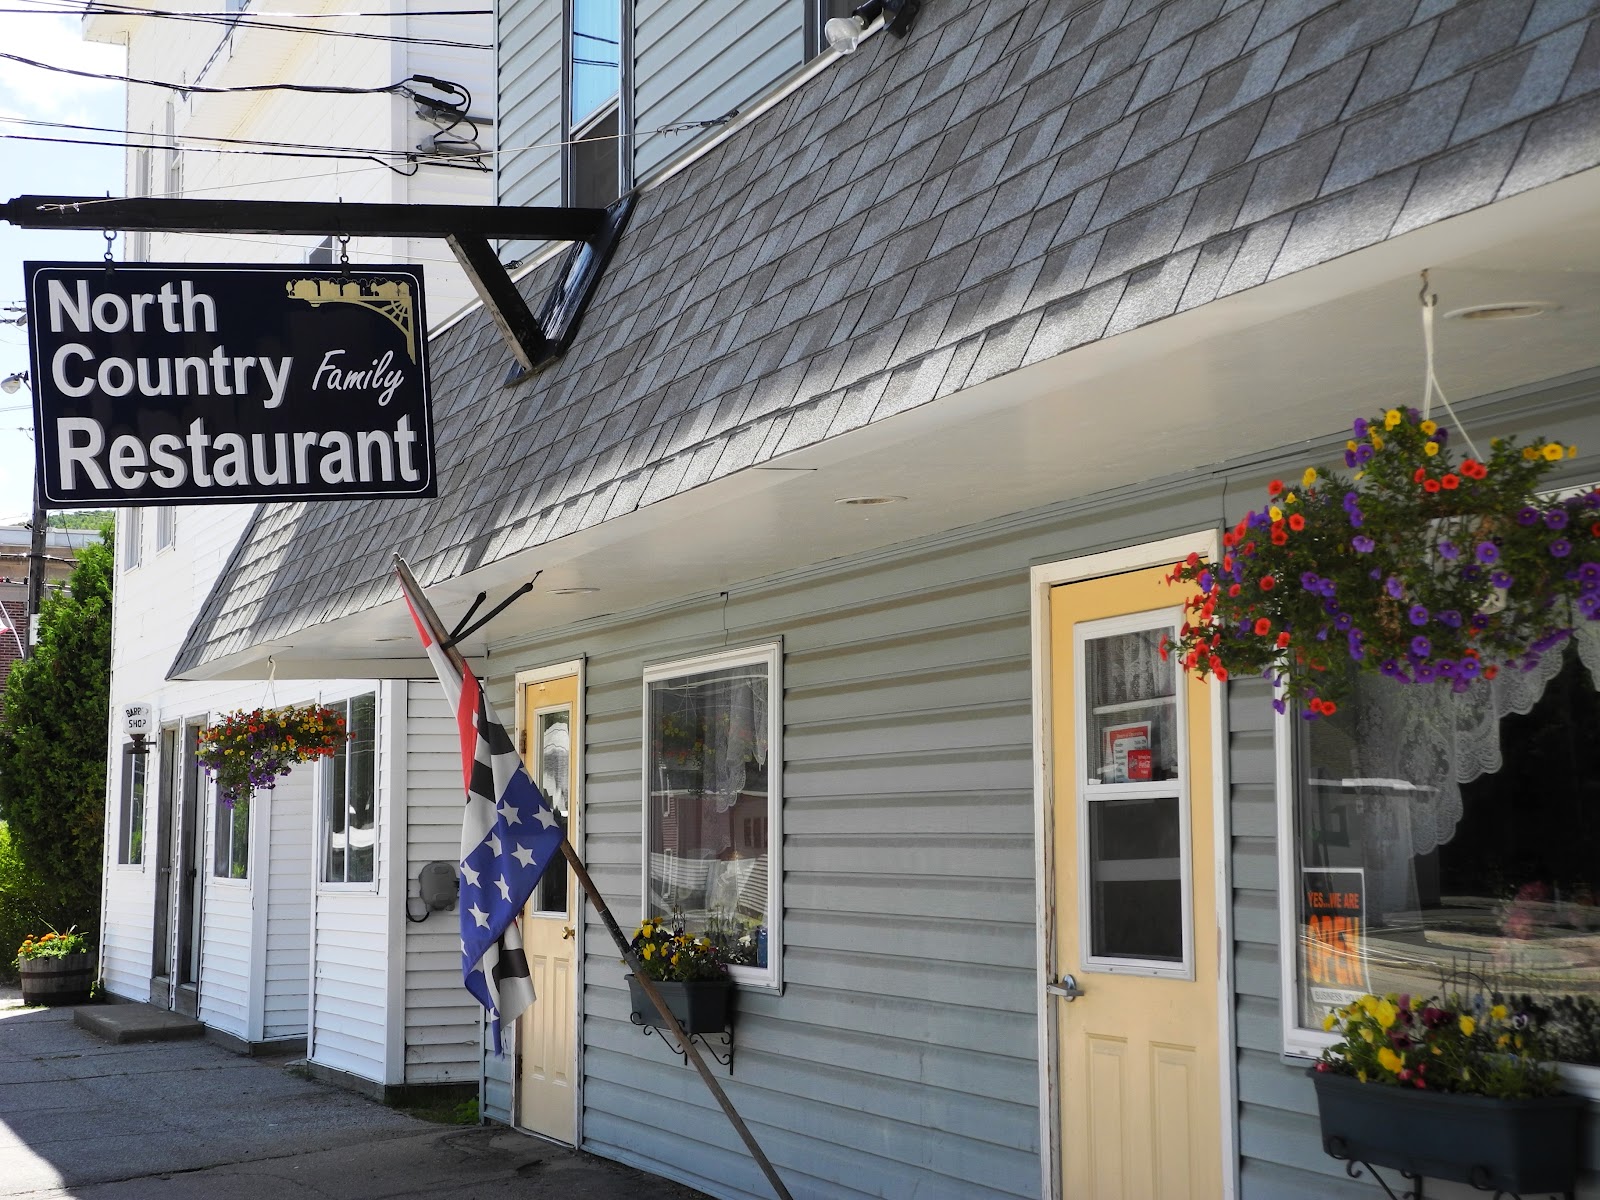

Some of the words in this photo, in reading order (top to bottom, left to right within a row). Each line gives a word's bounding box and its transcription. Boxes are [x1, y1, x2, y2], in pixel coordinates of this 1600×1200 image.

[47, 279, 218, 333] North
[52, 343, 294, 409] Country
[312, 349, 404, 406] Family
[56, 413, 420, 491] Restaurant
[128, 719, 147, 728] SHOP
[1344, 892, 1360, 909] ARE
[1308, 915, 1364, 987] OPEN
[1314, 991, 1344, 1003] BUSINESS
